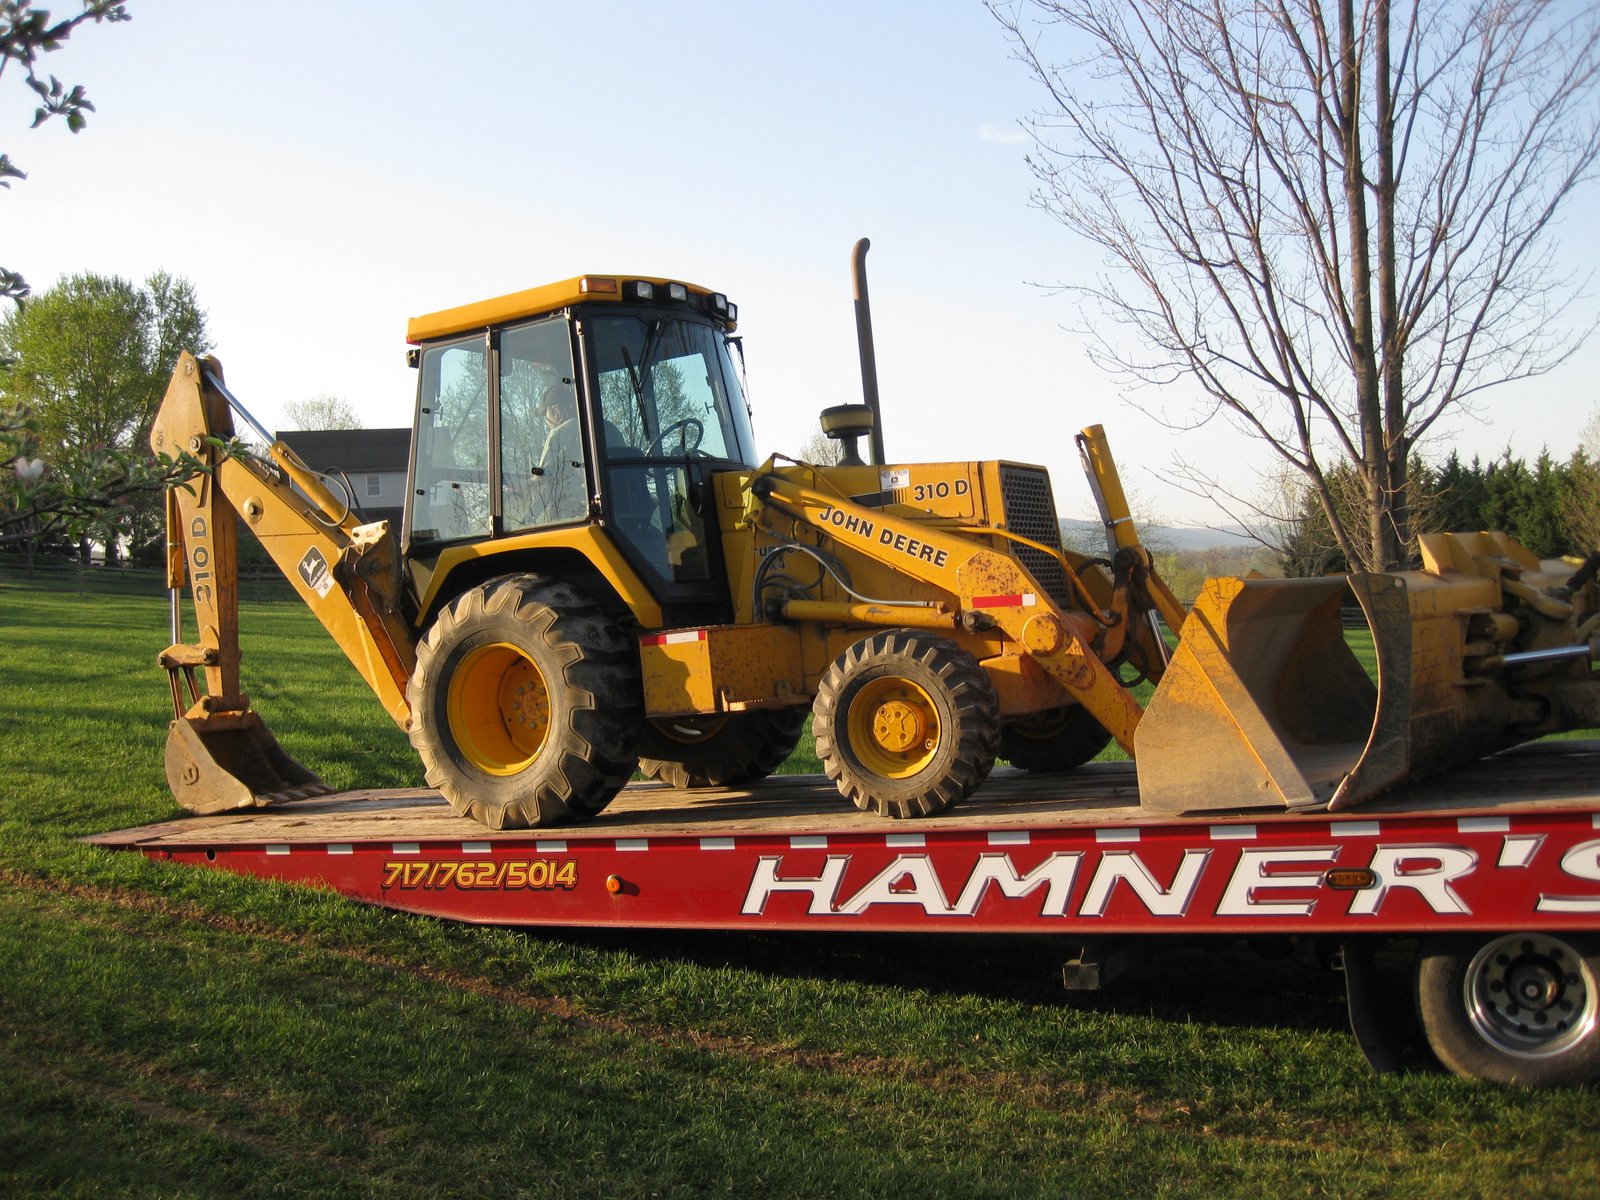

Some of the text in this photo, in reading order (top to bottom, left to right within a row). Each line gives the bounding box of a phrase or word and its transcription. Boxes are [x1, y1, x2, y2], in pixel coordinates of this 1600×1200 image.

[913, 479, 969, 502] 310 D
[190, 515, 213, 604] 310 D
[819, 505, 949, 569] JOHN DEERE
[381, 859, 578, 891] 717/762/5014
